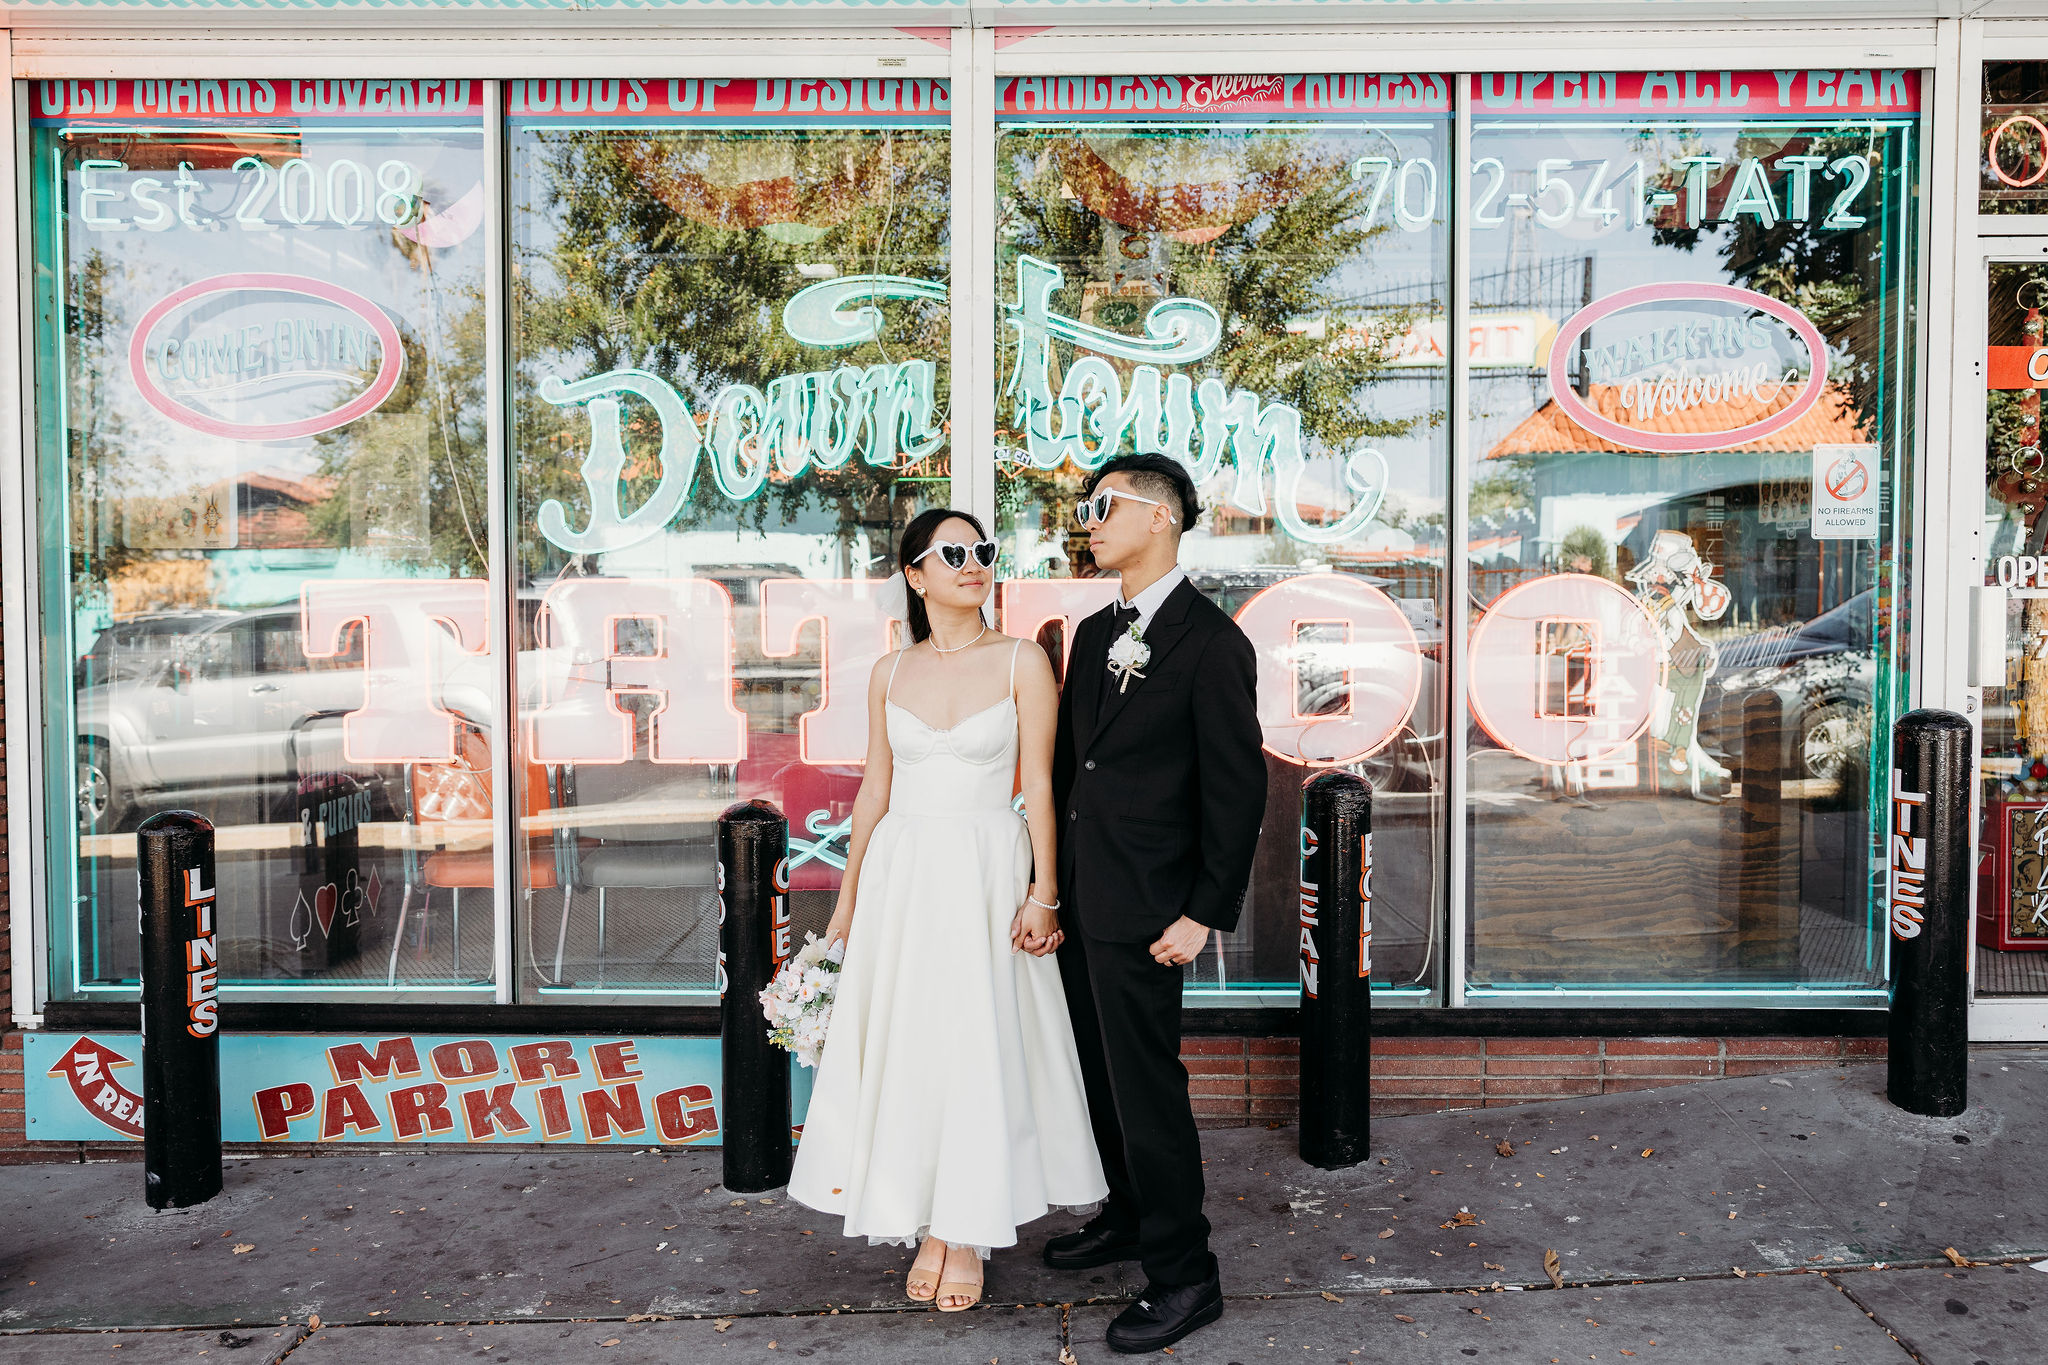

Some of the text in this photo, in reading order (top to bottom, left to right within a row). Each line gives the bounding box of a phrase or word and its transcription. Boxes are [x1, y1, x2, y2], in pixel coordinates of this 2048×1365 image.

[231, 157, 422, 230] 2008
[156, 317, 369, 382] COME ON IN
[1620, 361, 1798, 422] Welcome
[1817, 507, 1874, 516] NO FIREARMS
[1825, 519, 1866, 527] ALLOWED
[1892, 767, 1927, 942] LINES
[184, 865, 219, 1038] LINES
[74, 1051, 104, 1087] IN
[325, 1036, 646, 1087] MORE
[93, 1085, 144, 1127] REA
[252, 1080, 721, 1143] PARKING
